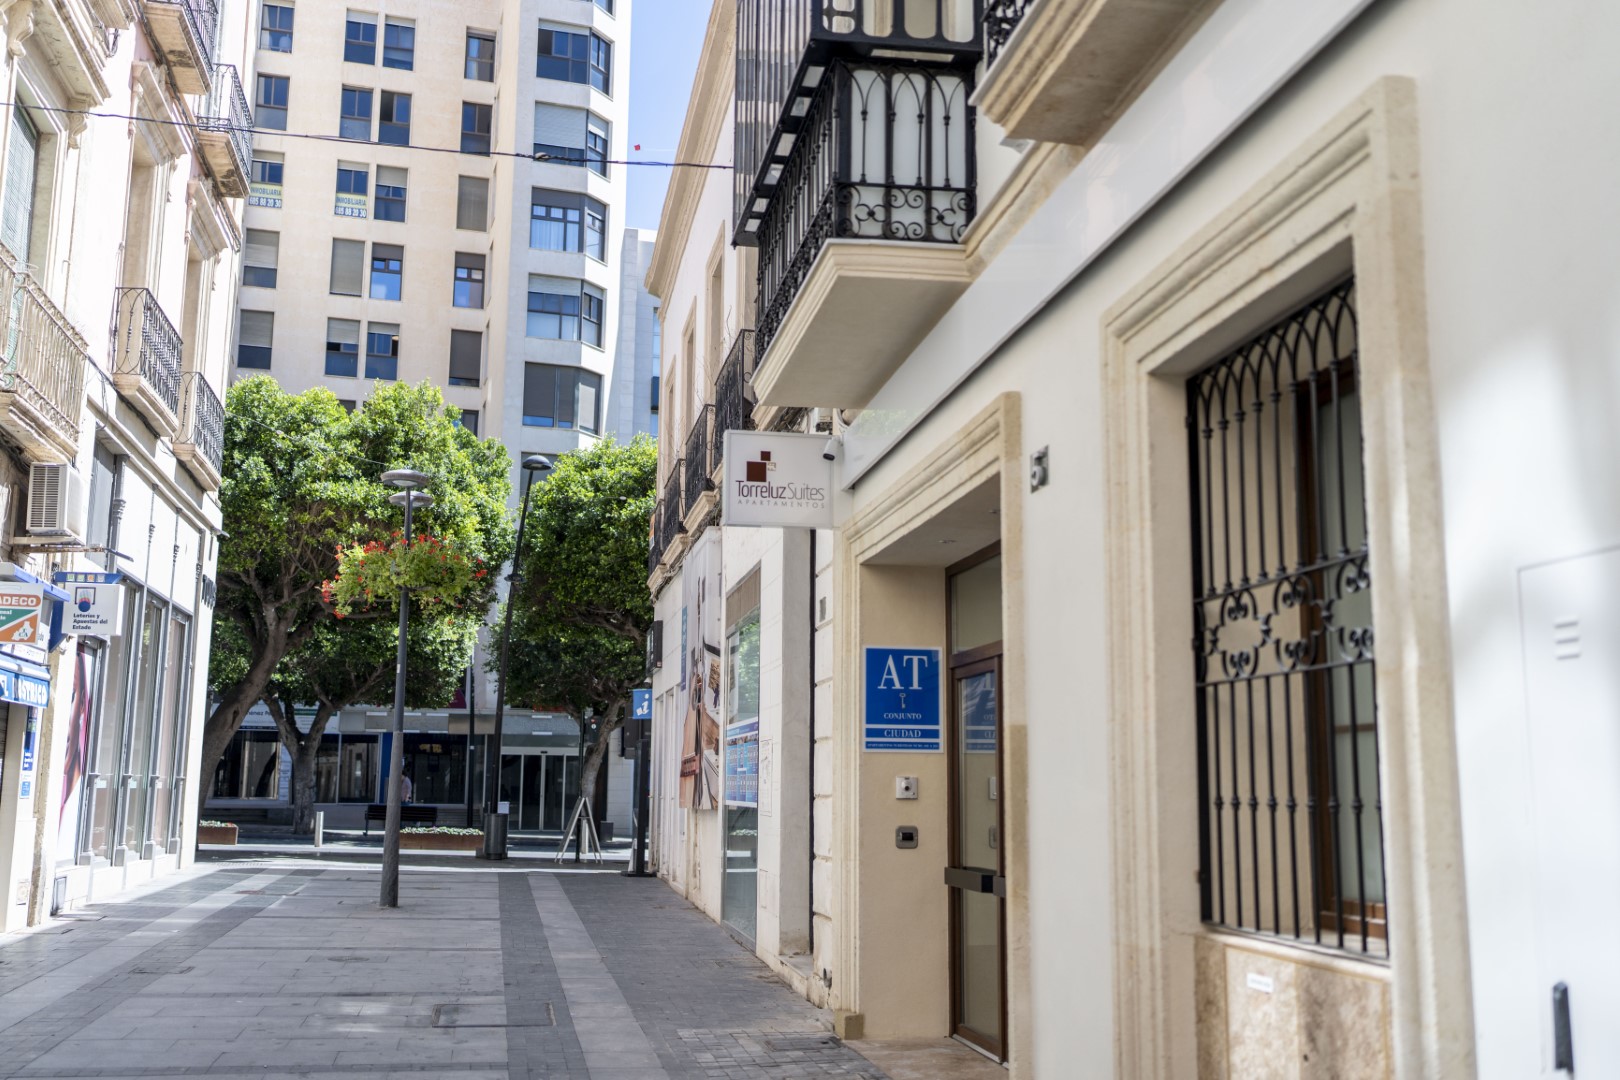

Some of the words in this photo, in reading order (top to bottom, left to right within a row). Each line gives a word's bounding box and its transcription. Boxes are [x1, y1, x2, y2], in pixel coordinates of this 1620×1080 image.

[1031, 447, 1047, 488] 5
[738, 500, 825, 509] APARTAMENTOS
[877, 654, 928, 690] AT
[883, 712, 922, 720] CONJUNTO
[884, 729, 922, 738] CIUDAD
